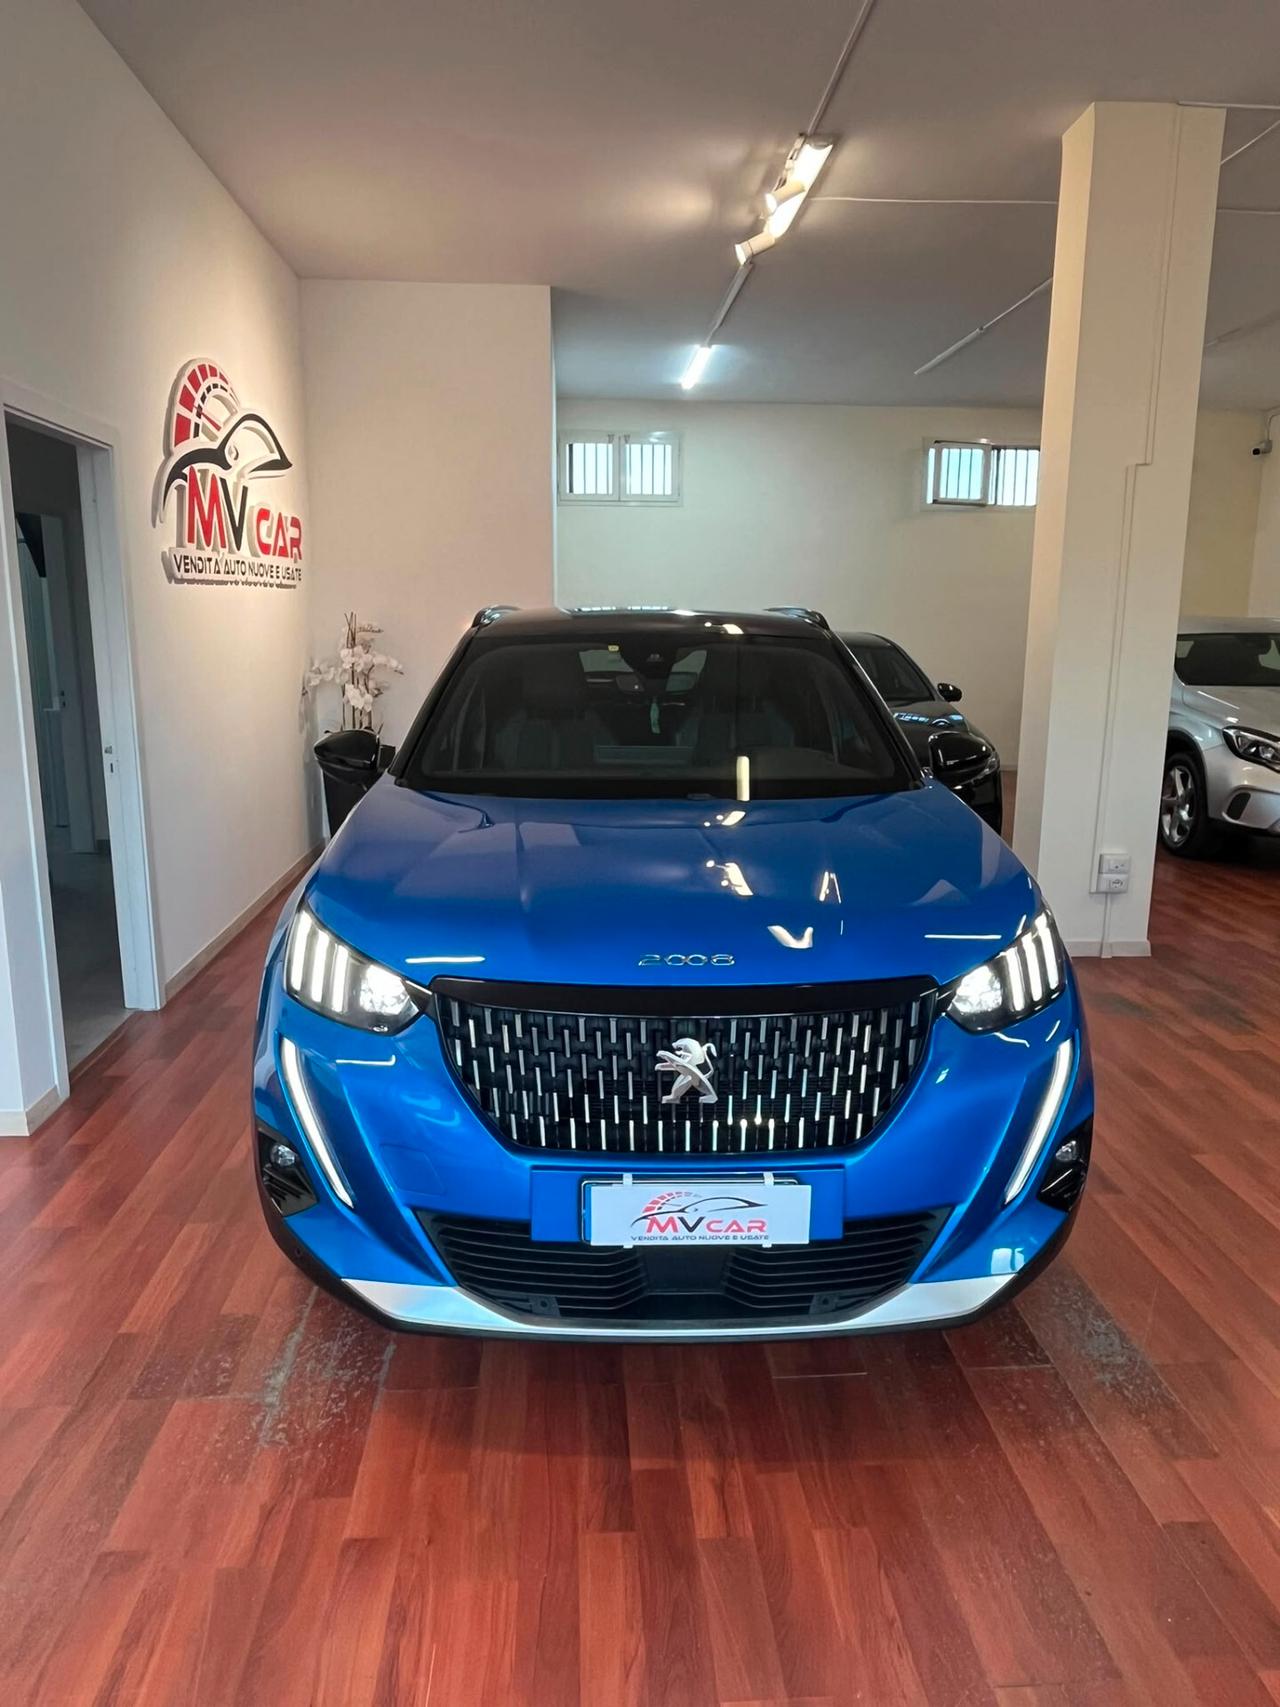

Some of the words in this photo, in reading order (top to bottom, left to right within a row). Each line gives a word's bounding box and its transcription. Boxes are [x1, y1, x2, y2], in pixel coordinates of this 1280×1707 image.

[173, 553, 221, 575] VENDITA
[223, 558, 247, 576] AUTO
[248, 562, 274, 579] NUOVE
[275, 564, 280, 579] E
[281, 566, 302, 582] USATE
[638, 953, 735, 967] 2008
